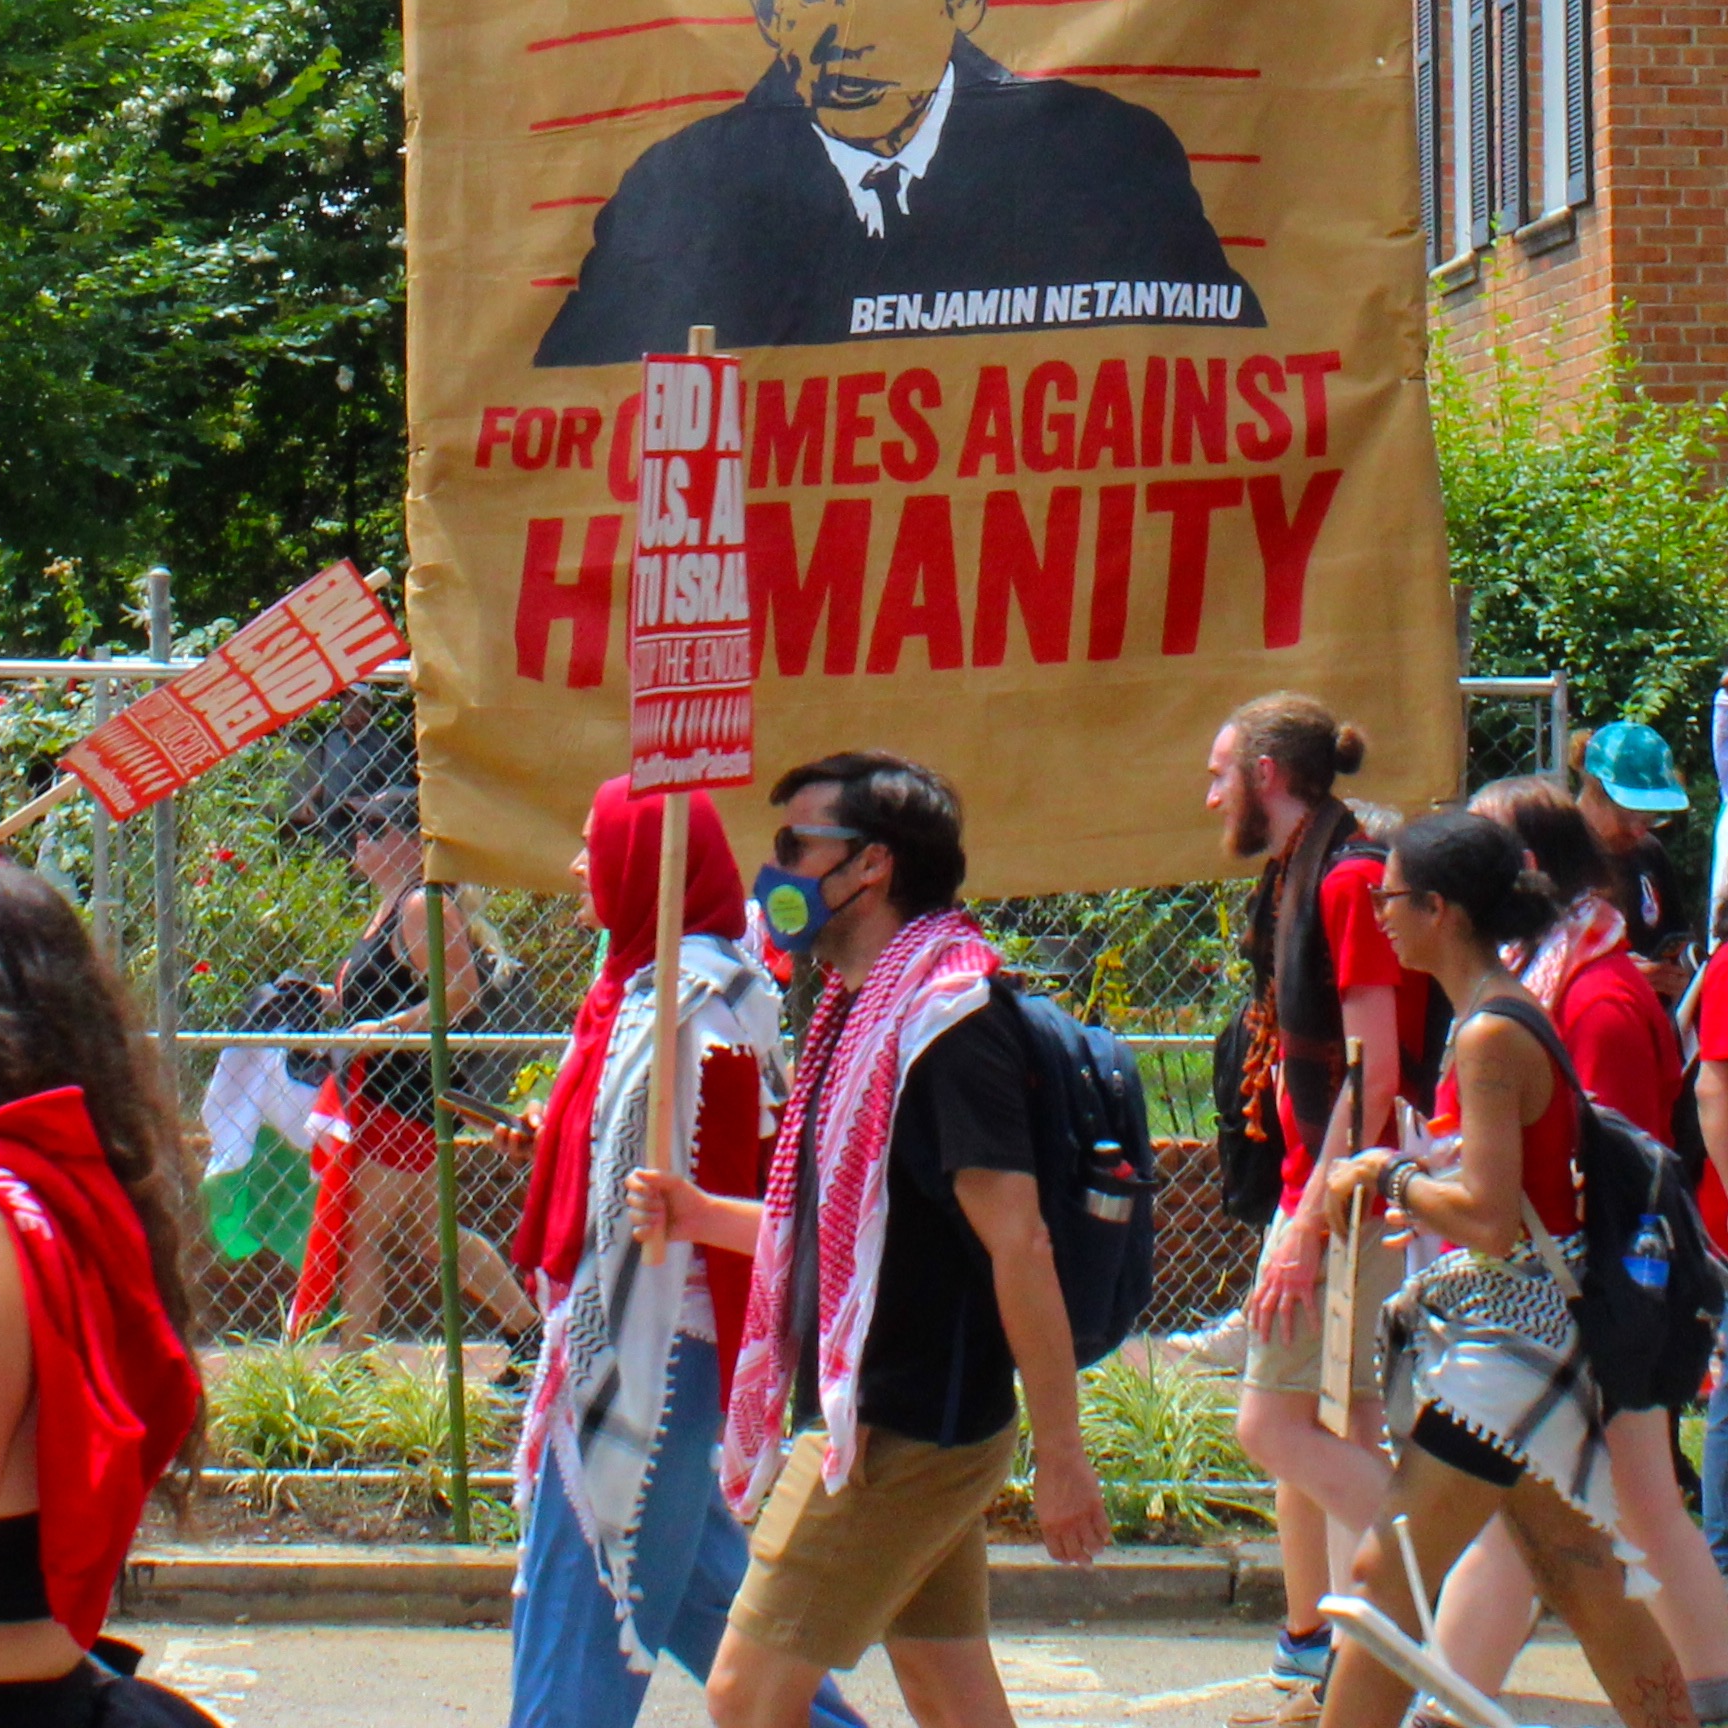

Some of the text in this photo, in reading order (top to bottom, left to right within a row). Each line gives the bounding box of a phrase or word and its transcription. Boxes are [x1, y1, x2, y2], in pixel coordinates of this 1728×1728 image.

[849, 280, 1243, 334] BENJAMIN NETANYAHU
[474, 404, 602, 472] FOR
[607, 366, 943, 503] CMES
[957, 350, 1342, 478] AGAINST
[514, 468, 1346, 689] HMANITY
[311, 596, 401, 683] ALL
